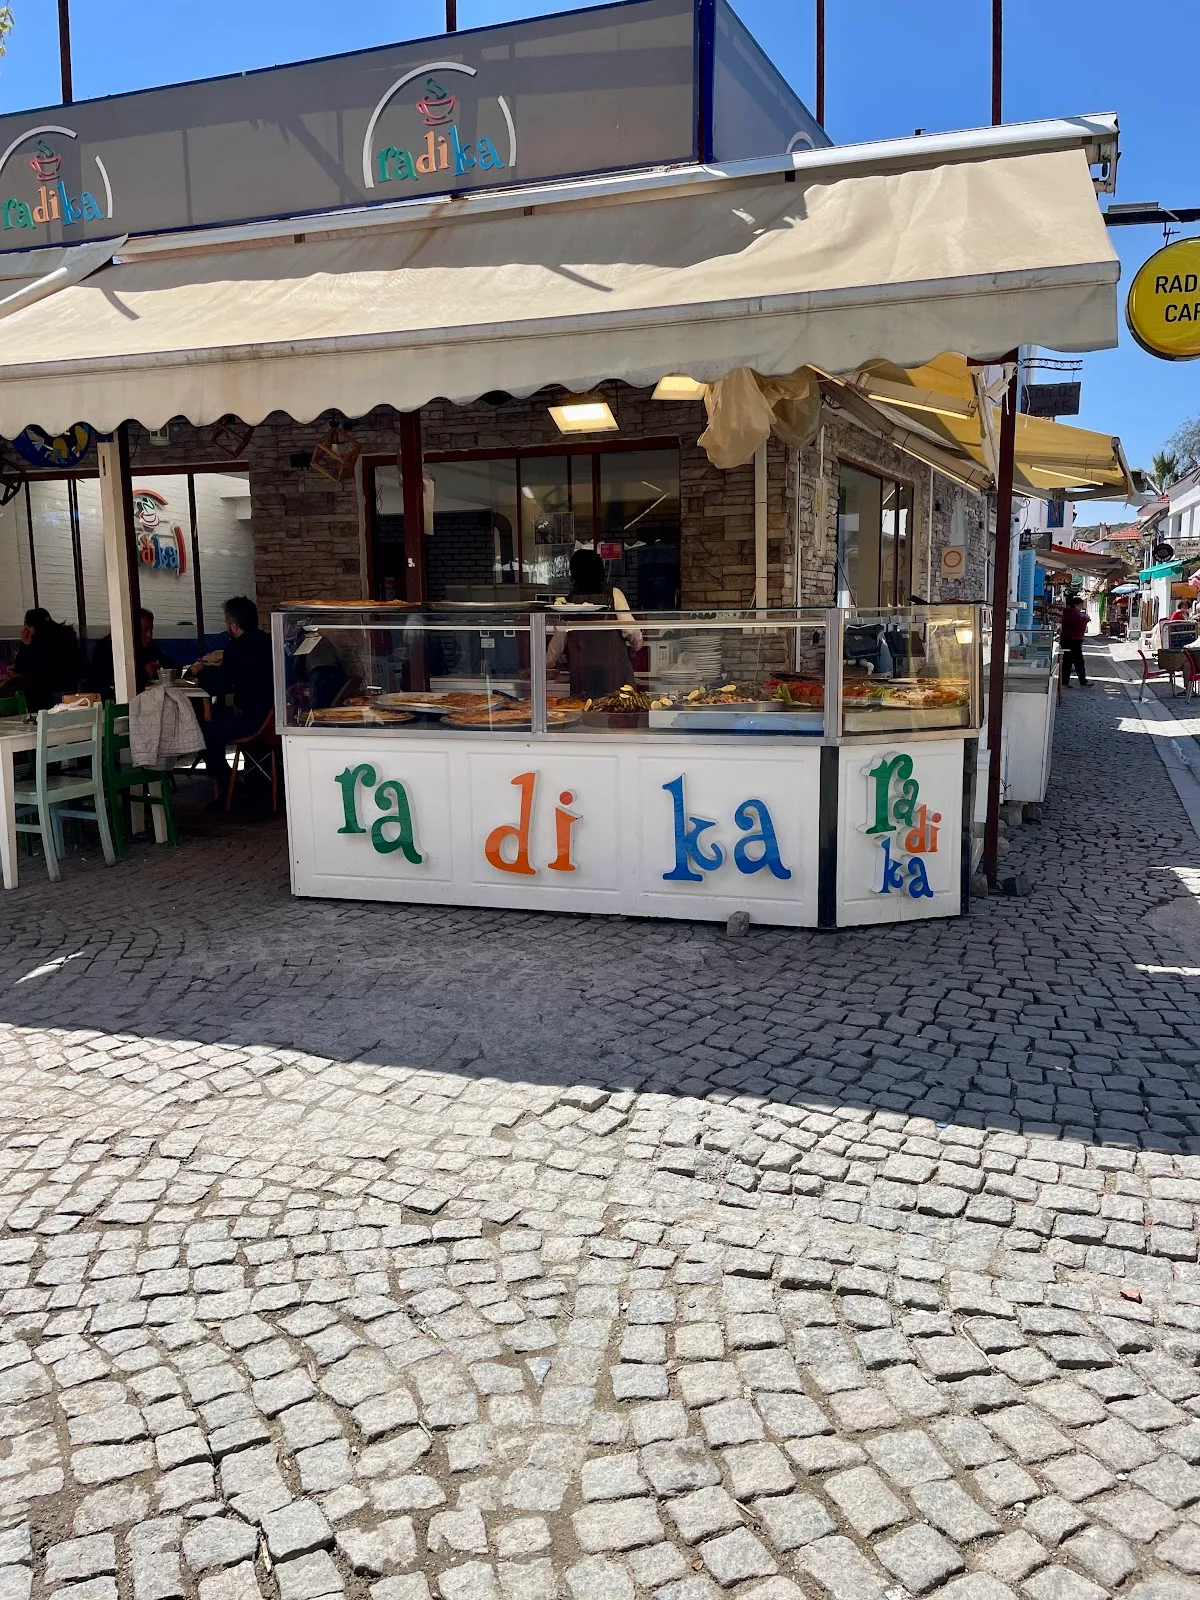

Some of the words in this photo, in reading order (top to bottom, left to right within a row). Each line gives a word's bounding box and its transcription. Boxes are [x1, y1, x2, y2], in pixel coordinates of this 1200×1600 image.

[376, 124, 505, 183] radika
[1, 180, 105, 231] radika
[1155, 274, 1200, 294] RAD
[137, 533, 178, 569] dika
